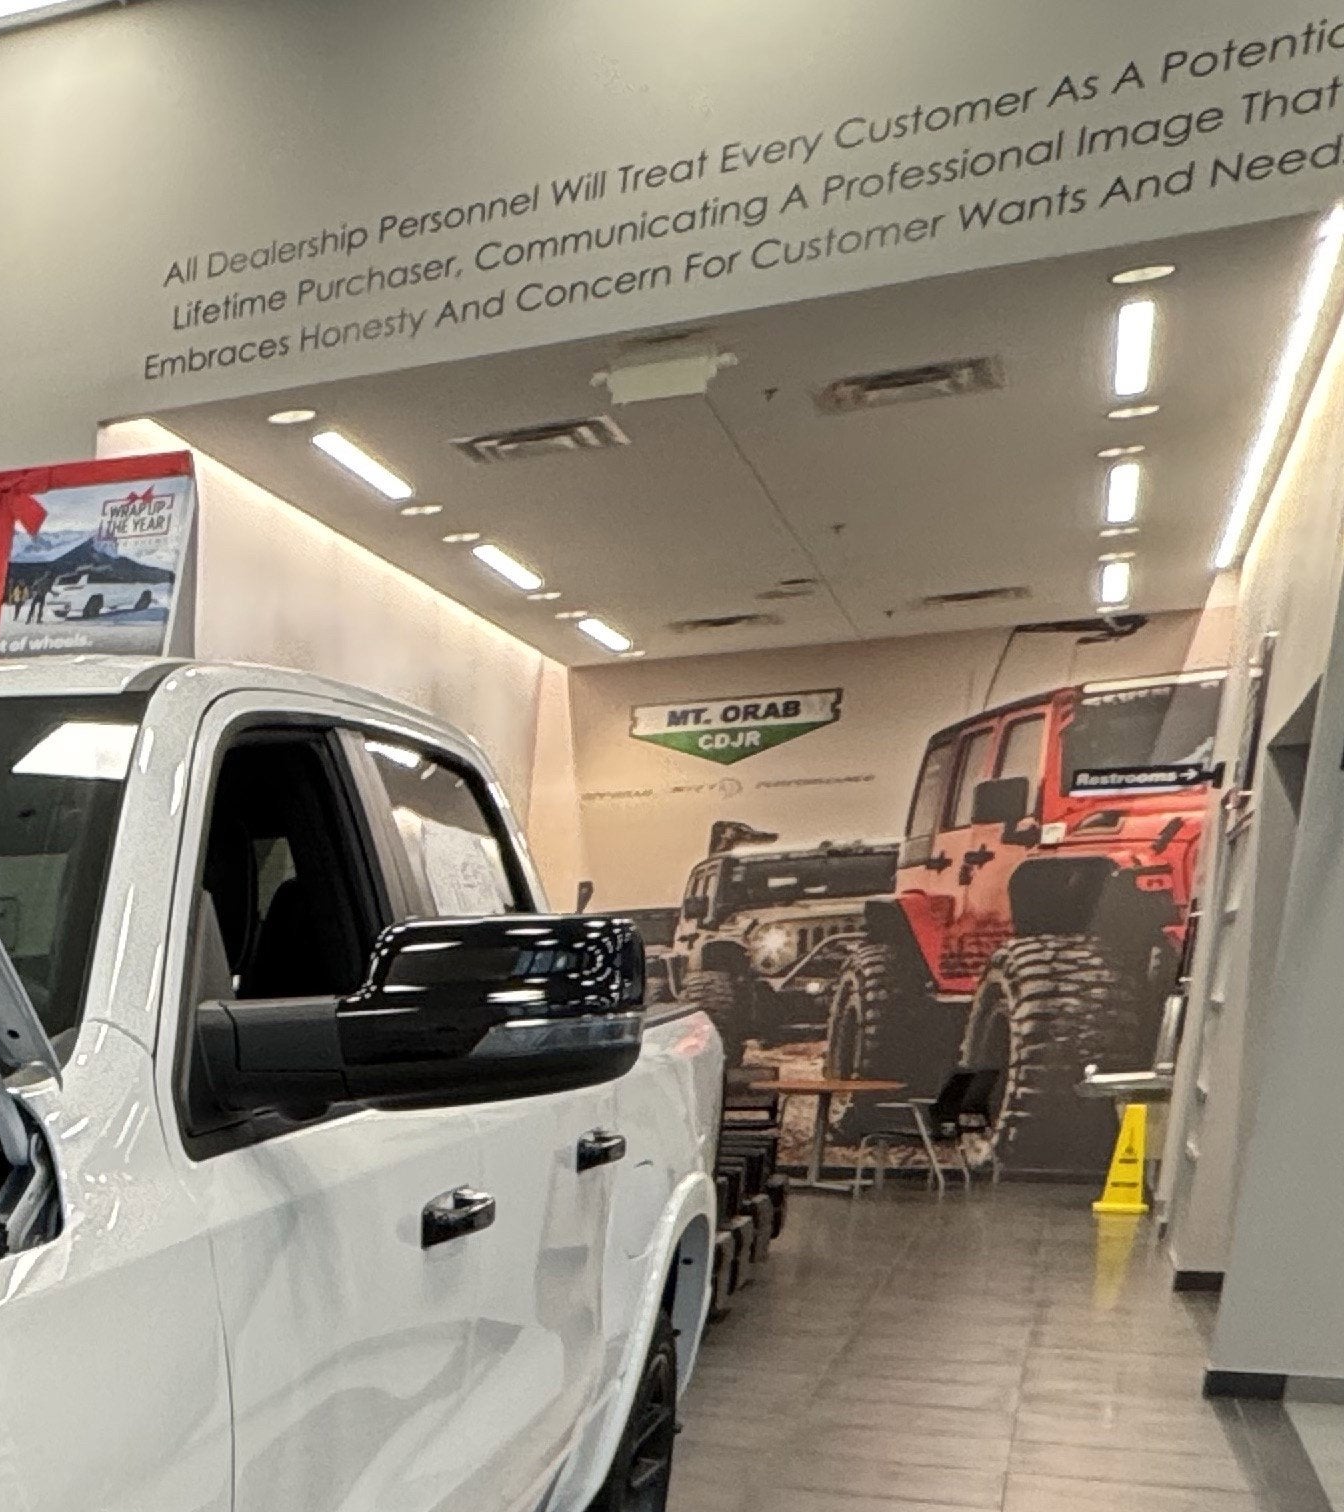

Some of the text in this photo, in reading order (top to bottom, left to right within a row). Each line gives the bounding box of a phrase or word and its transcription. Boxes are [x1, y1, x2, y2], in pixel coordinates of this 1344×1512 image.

[163, 256, 197, 288] All
[206, 223, 368, 279] Dealership
[378, 183, 540, 243] Personnel
[551, 170, 607, 207] Will
[618, 149, 710, 193] Treat
[720, 131, 824, 174] Every
[834, 86, 1038, 149] Customer
[1046, 75, 1100, 108] As
[1111, 61, 1145, 95] A
[173, 75, 1343, 330] Lifetime Purchaser, Communicating A Professional Image That
[144, 134, 1344, 380] Embraces Honesty And Concern For Customer Wants And Need
[132, 514, 166, 533] YEAR
[667, 701, 801, 727] MT. ORAB
[698, 730, 761, 750] CDJR
[1076, 772, 1178, 786] Restrooms
